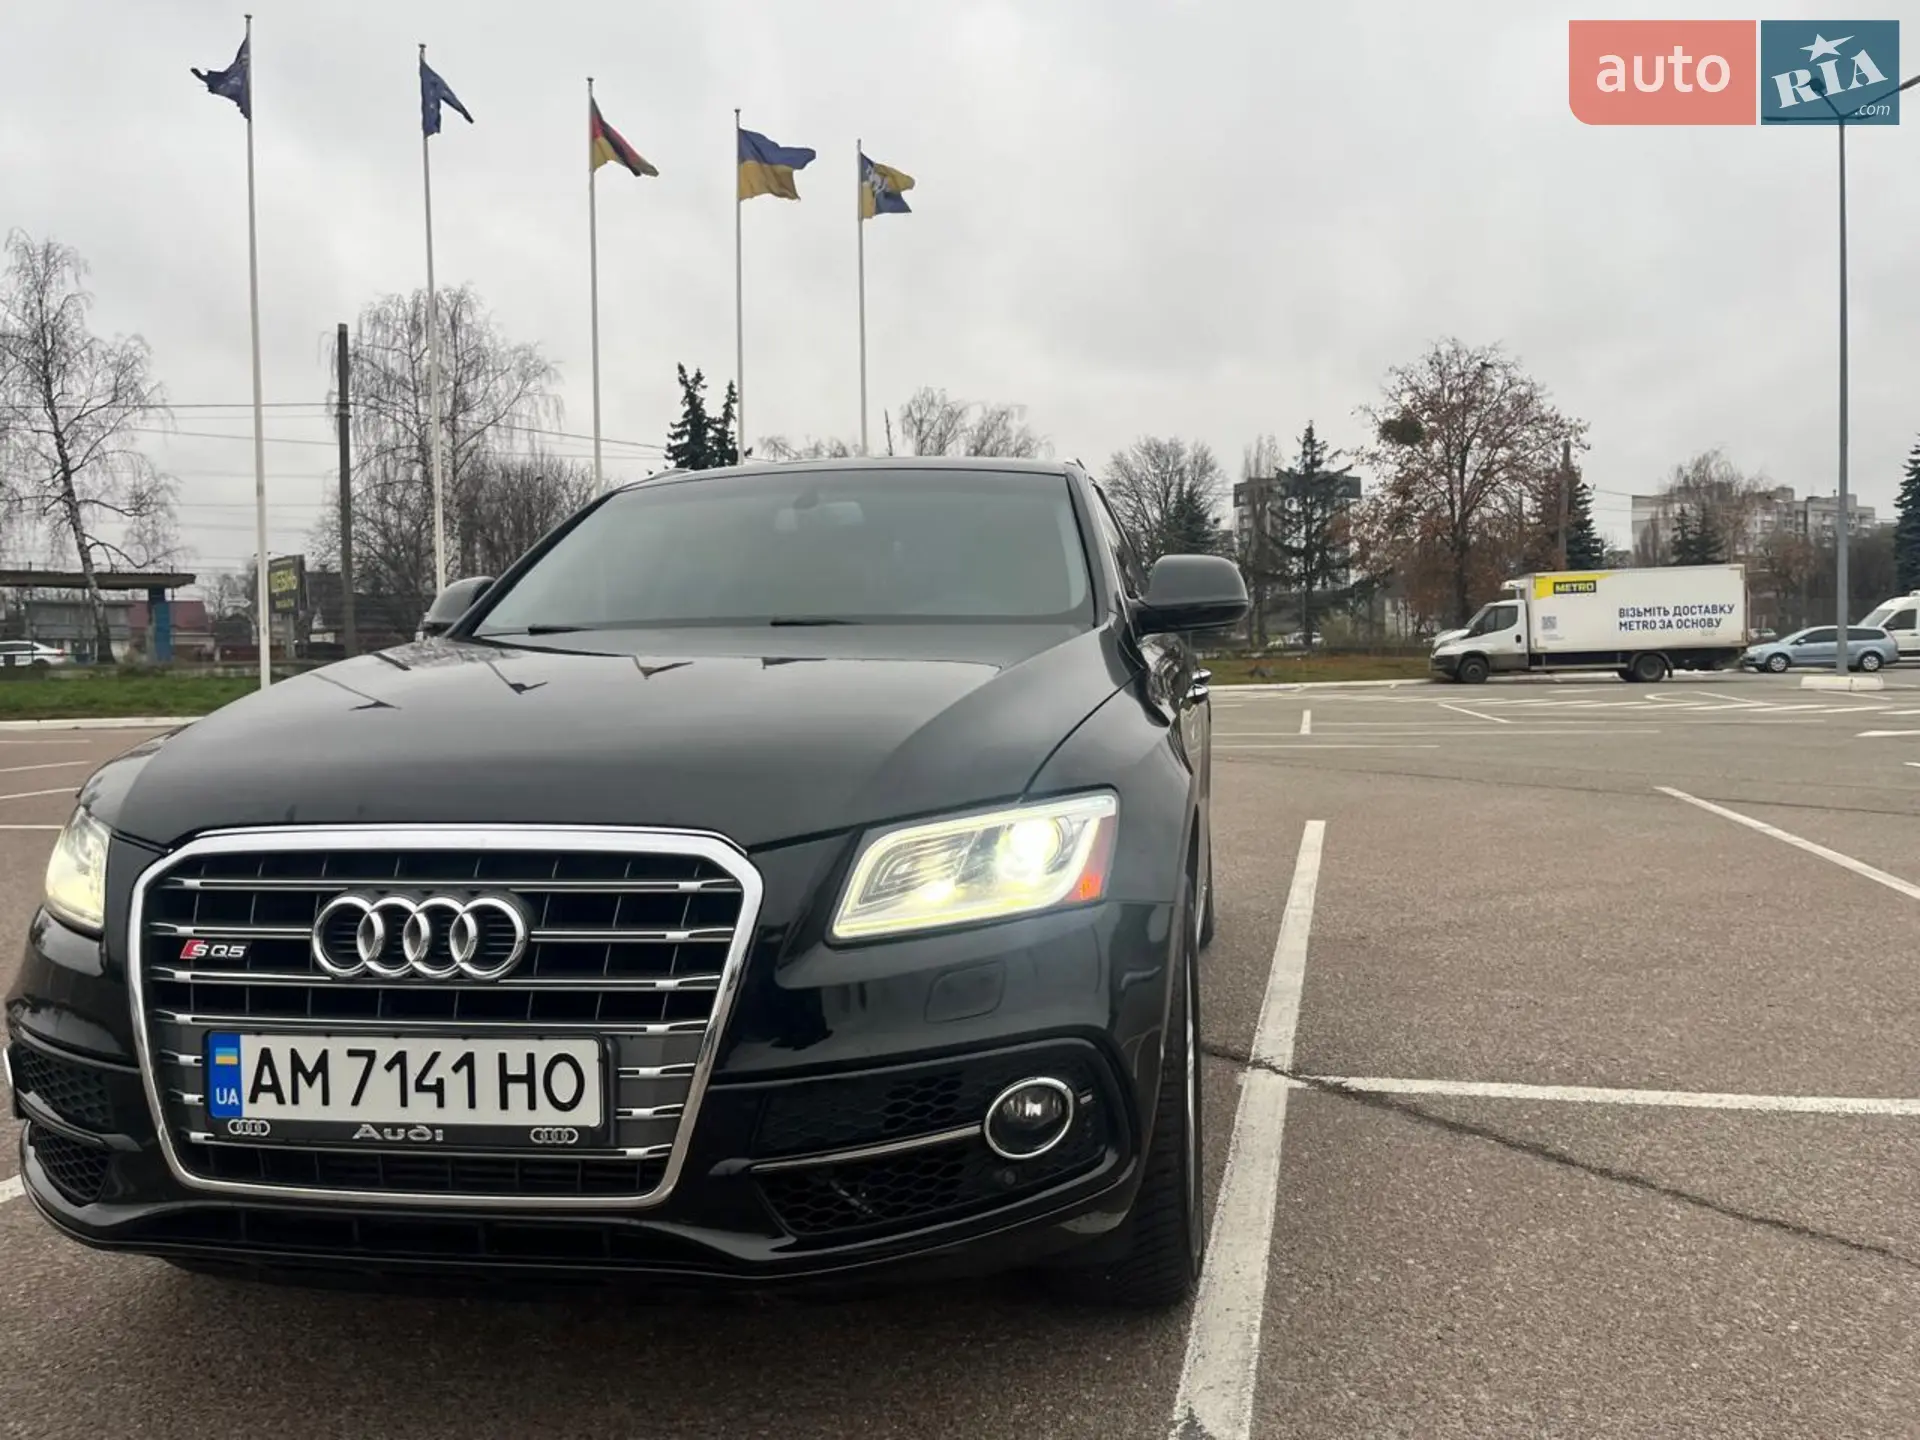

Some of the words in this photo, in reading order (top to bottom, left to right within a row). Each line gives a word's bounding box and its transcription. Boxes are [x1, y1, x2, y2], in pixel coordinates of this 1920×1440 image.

[1555, 582, 1595, 593] METRO
[1618, 606, 1670, 618] ВІЗЬМІТЬ
[1672, 603, 1735, 617] ДОСТАВКУ
[1619, 620, 1657, 631] METRO
[1659, 619, 1673, 630] ЗА
[1676, 617, 1722, 629] ОСНОВУ
[191, 943, 247, 959] SQ5
[248, 1046, 331, 1107] AM
[347, 1048, 476, 1110] 7141
[498, 1052, 586, 1112] HO
[215, 1087, 240, 1106] UA
[352, 1123, 444, 1142] Audi
